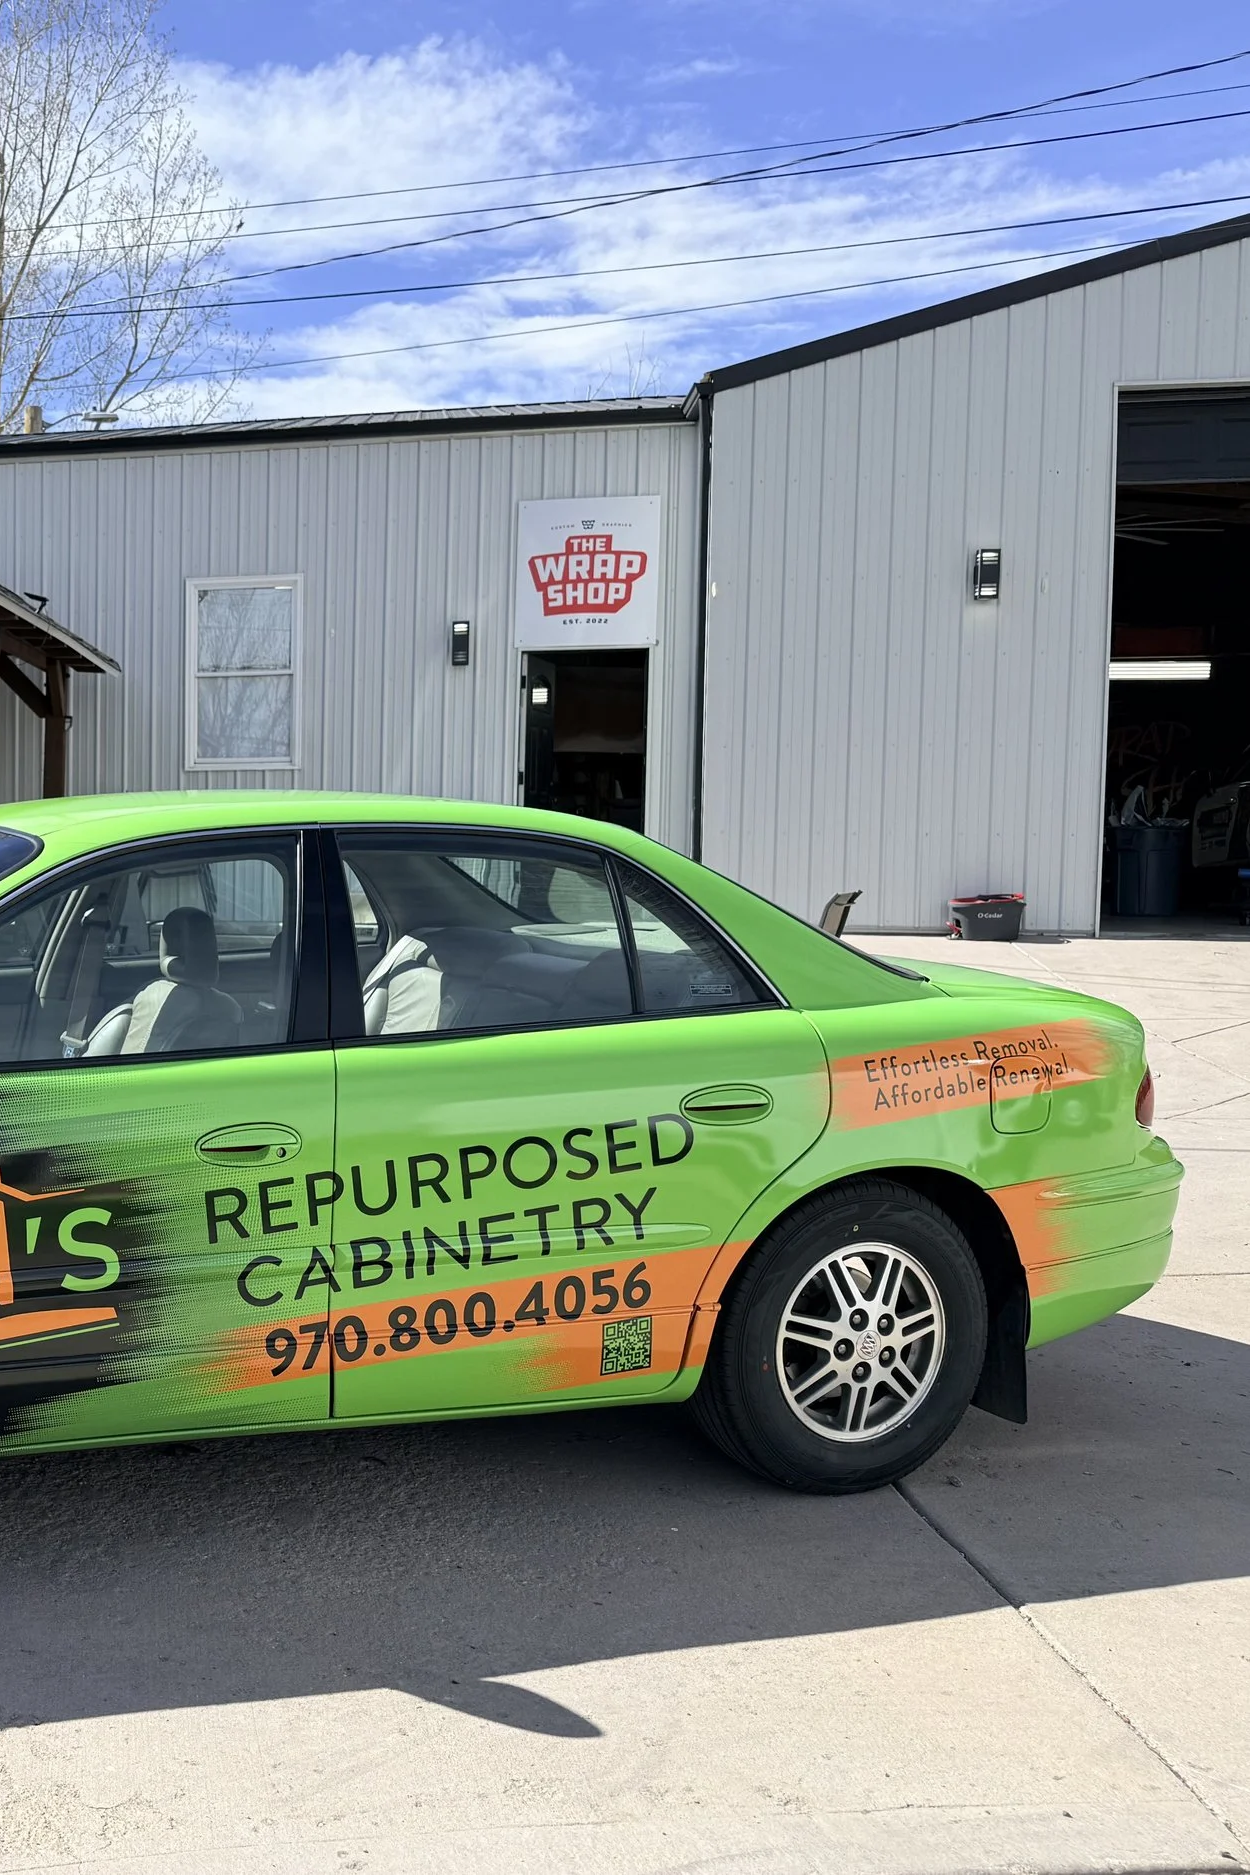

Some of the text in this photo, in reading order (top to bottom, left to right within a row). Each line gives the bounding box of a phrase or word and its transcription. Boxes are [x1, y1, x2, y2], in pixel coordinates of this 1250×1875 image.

[534, 554, 641, 583] WRAP
[569, 538, 607, 553] THE
[547, 582, 627, 608] SHOP
[586, 617, 609, 625] 2022
[863, 1029, 1059, 1084] Effortless Removal.
[873, 1053, 1075, 1112] Affordable Renewal.
[204, 1113, 695, 1244] REPURPOSED
[236, 1186, 658, 1308] CABINETRY
[264, 1262, 653, 1377] 970.800.4056
